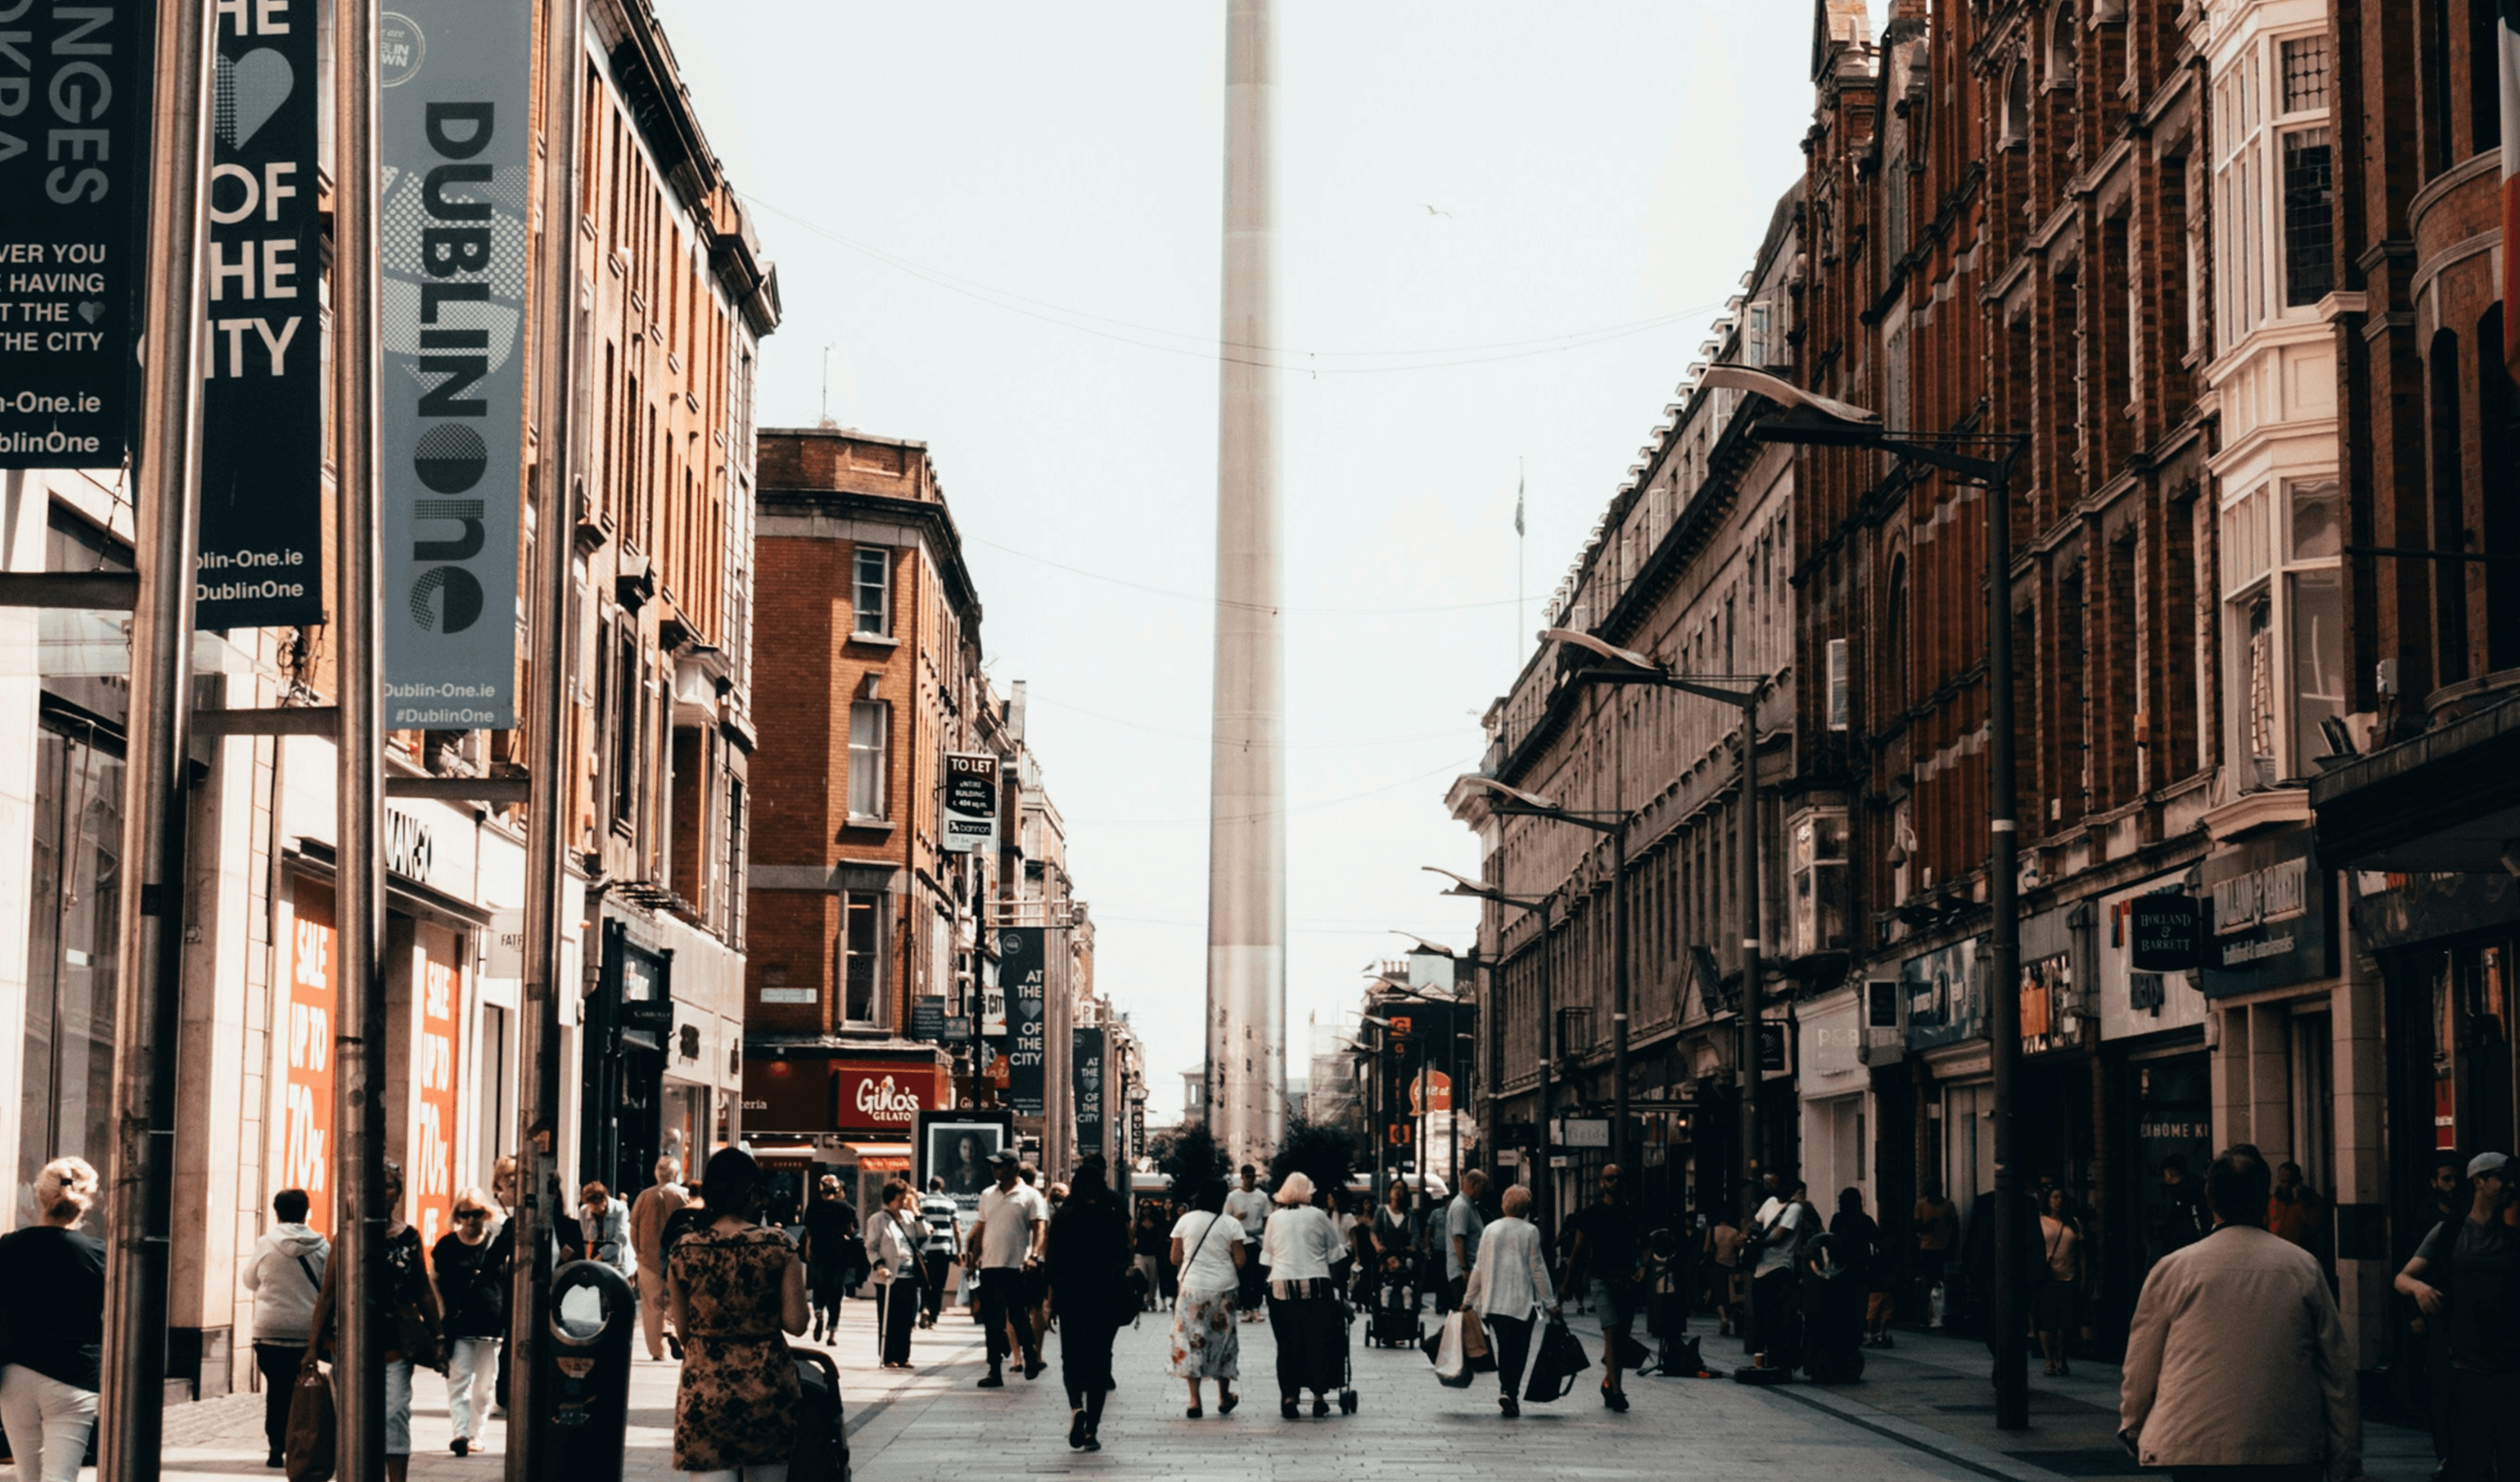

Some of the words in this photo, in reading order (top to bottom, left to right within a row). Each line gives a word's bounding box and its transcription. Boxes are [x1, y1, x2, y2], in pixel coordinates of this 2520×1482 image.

[219, 0, 290, 36] HE
[211, 162, 297, 224] OF
[52, 243, 107, 263] YOU
[210, 239, 298, 301] HE
[10, 273, 105, 293] HAVING
[19, 303, 69, 321] THE
[0, 332, 38, 351] HE
[47, 332, 104, 351] CITY
[136, 316, 302, 379] ITY
[195, 580, 304, 601] DublinOne
[384, 682, 495, 697] Dublin-One.ie
[396, 707, 495, 722] #DublinOne
[951, 759, 970, 771] TO
[971, 759, 992, 773] LET
[2140, 914, 2191, 927] HOLLAND
[2161, 926, 2171, 938] &
[2141, 939, 2190, 952] BARRETT
[296, 919, 328, 989] SALE
[1025, 970, 1043, 983] AT
[427, 960, 450, 1021] SALE
[1017, 985, 1042, 998] THE
[1021, 1022, 1042, 1035] OF
[290, 1001, 309, 1068] UP
[309, 1003, 327, 1073] TO
[1017, 1037, 1042, 1050] THE
[1010, 1052, 1042, 1066] CITY
[1087, 1057, 1099, 1067] AT
[1081, 1068, 1099, 1077] THE
[1084, 1092, 1099, 1102] OF
[1082, 1102, 1099, 1112] THE
[872, 1111, 912, 1121] GELATO
[1077, 1113, 1100, 1123] CITY
[2152, 1123, 2189, 1137] HOME
[285, 1083, 325, 1193] 70%
